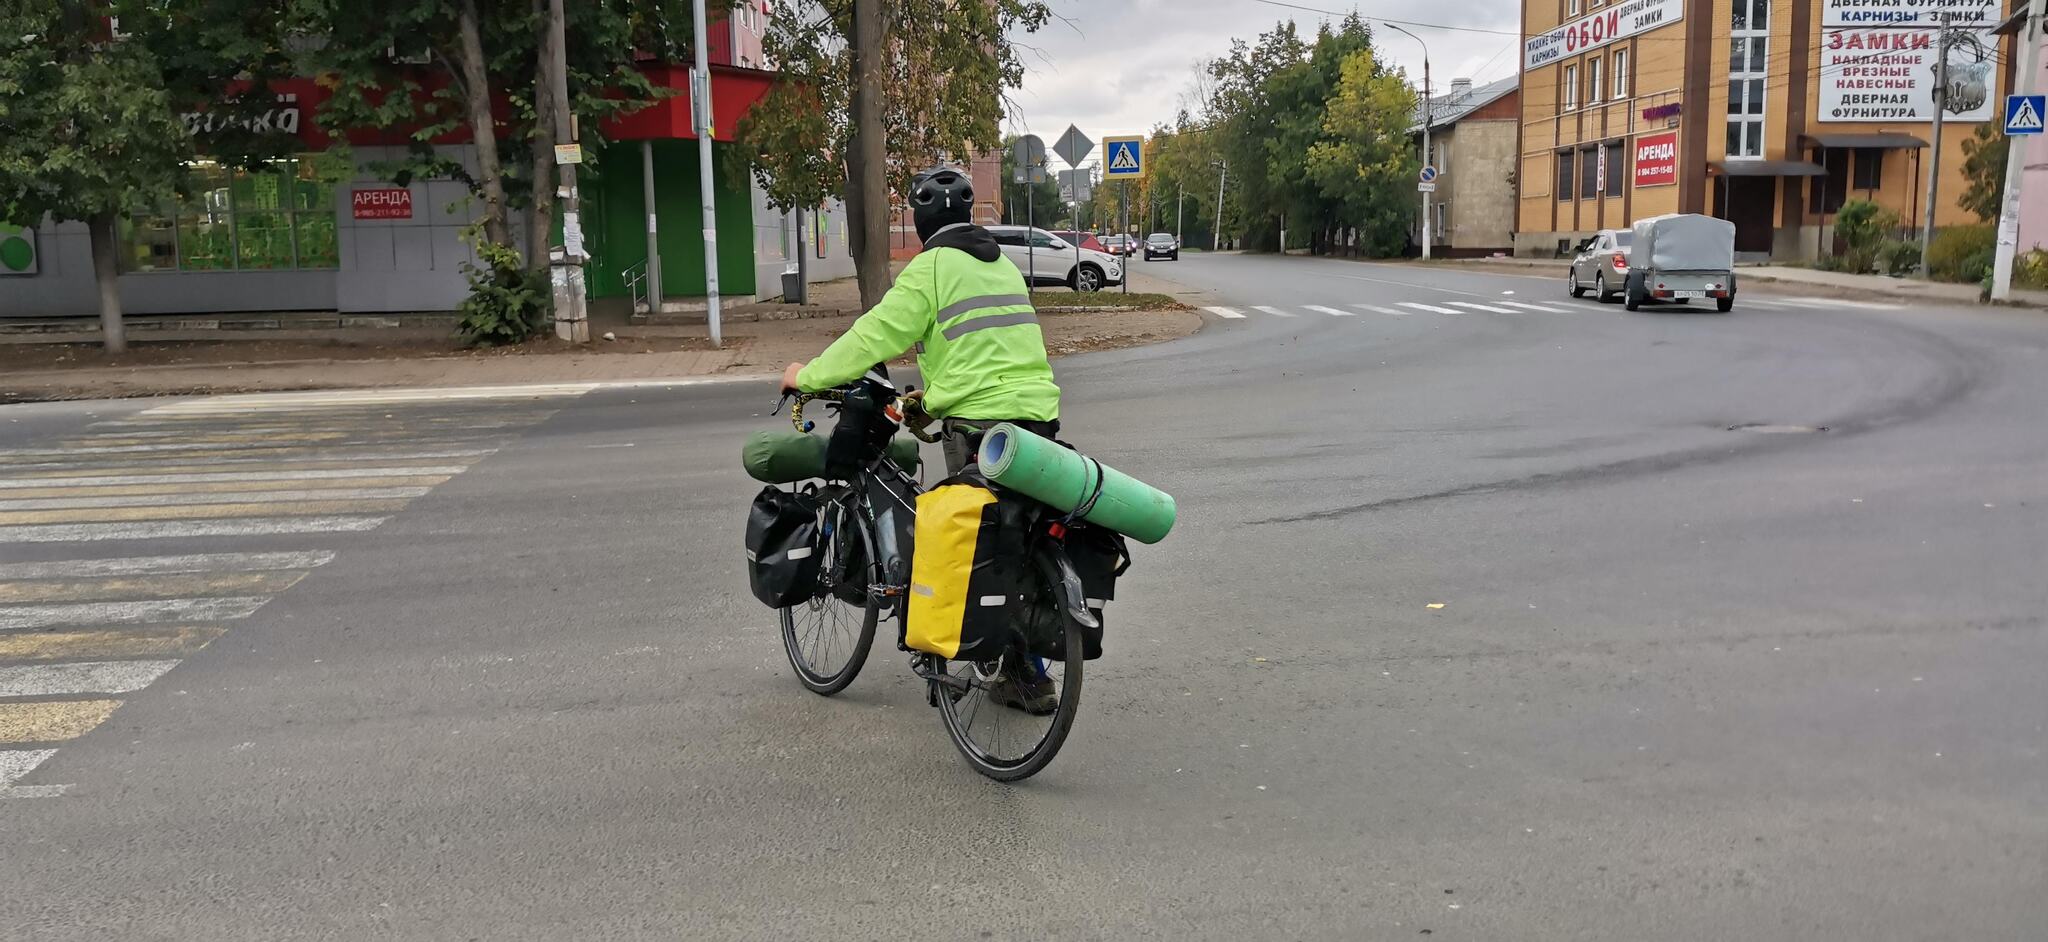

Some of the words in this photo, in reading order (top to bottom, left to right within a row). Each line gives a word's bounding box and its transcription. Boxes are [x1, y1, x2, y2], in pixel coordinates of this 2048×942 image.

[1620, 1, 1644, 19] ДВЕРНАЯ
[1831, 0, 1905, 8] ДВЕРНАЯ
[1634, 9, 1663, 29] ЗАМКИ
[1841, 11, 1918, 22] КАРНИЗЫ
[1566, 9, 1619, 52] ОБОИ
[1527, 35, 1549, 52] ЖИДКИЕ
[1550, 29, 1565, 44] ОБОИ
[1828, 32, 1929, 50] ЗАМКИ
[1531, 46, 1559, 65] КАРНИЗЫ
[1832, 55, 1922, 65] НАКЛАДНЫЕ
[1842, 67, 1910, 76] ВРЕЗНЫЕ
[1836, 80, 1916, 89] НАВЕСНЫЕ
[1840, 94, 1908, 106] ДВЕРНАЯ
[1832, 108, 1916, 118] ФУРНИТУРА
[1638, 143, 1674, 161] АРЕНДА
[354, 191, 410, 206] АРЕНДА
